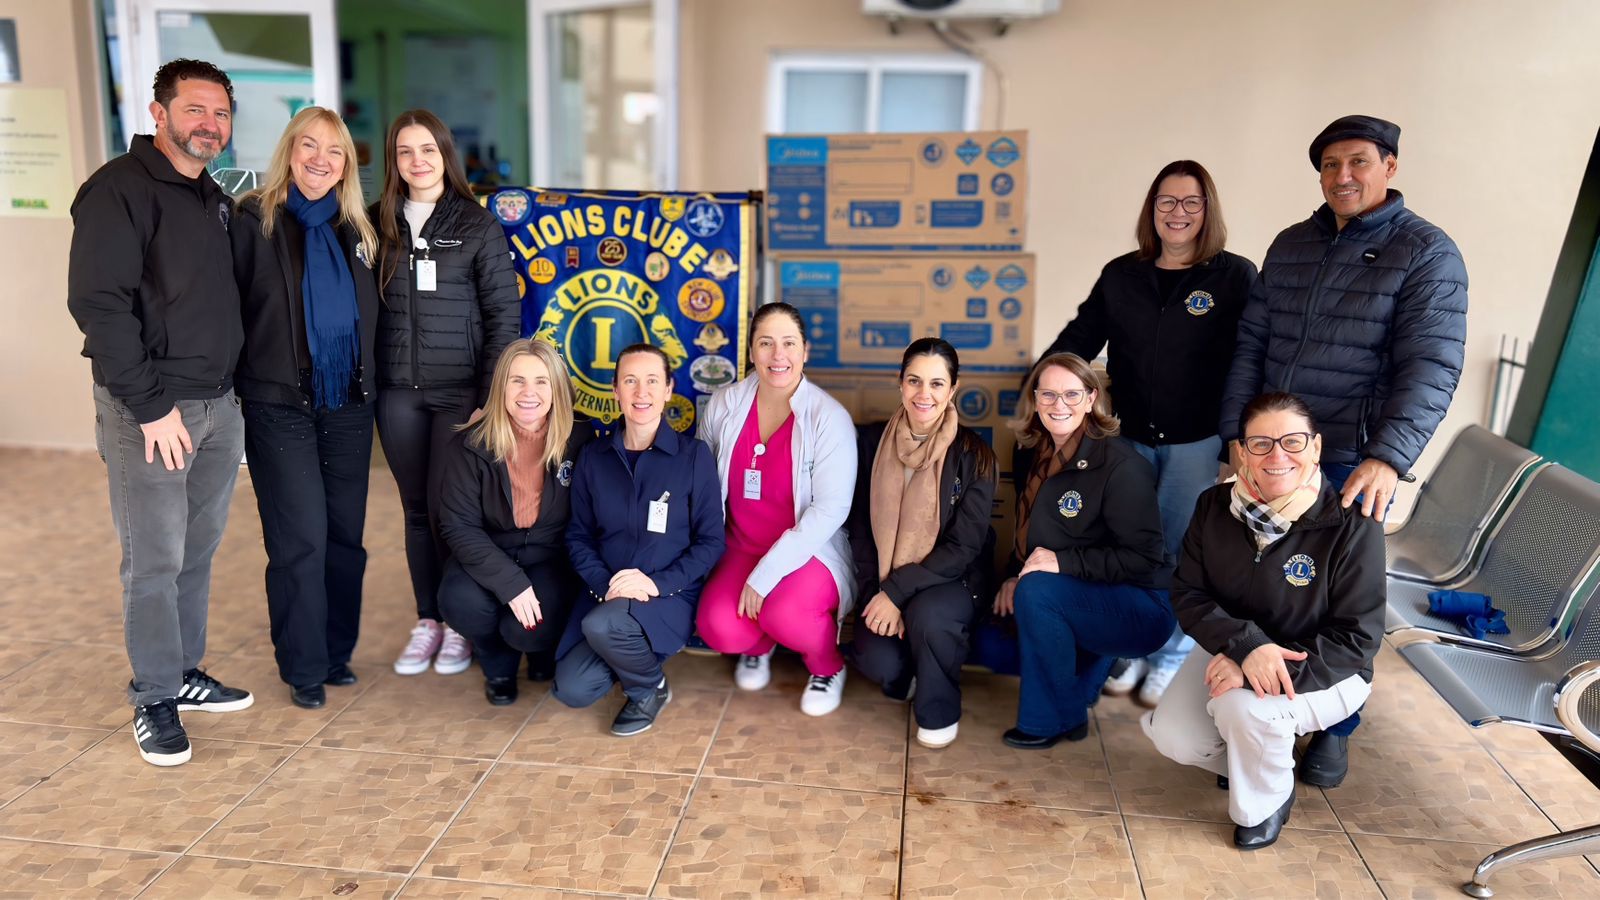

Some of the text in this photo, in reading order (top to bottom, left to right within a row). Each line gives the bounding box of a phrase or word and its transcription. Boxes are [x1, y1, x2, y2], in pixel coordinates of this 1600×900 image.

[510, 205, 709, 274] LIONS CLUBE
[536, 259, 550, 273] 10
[563, 273, 653, 310] LIONS
[576, 388, 622, 412] TERNATI
[1296, 564, 1304, 576] L
